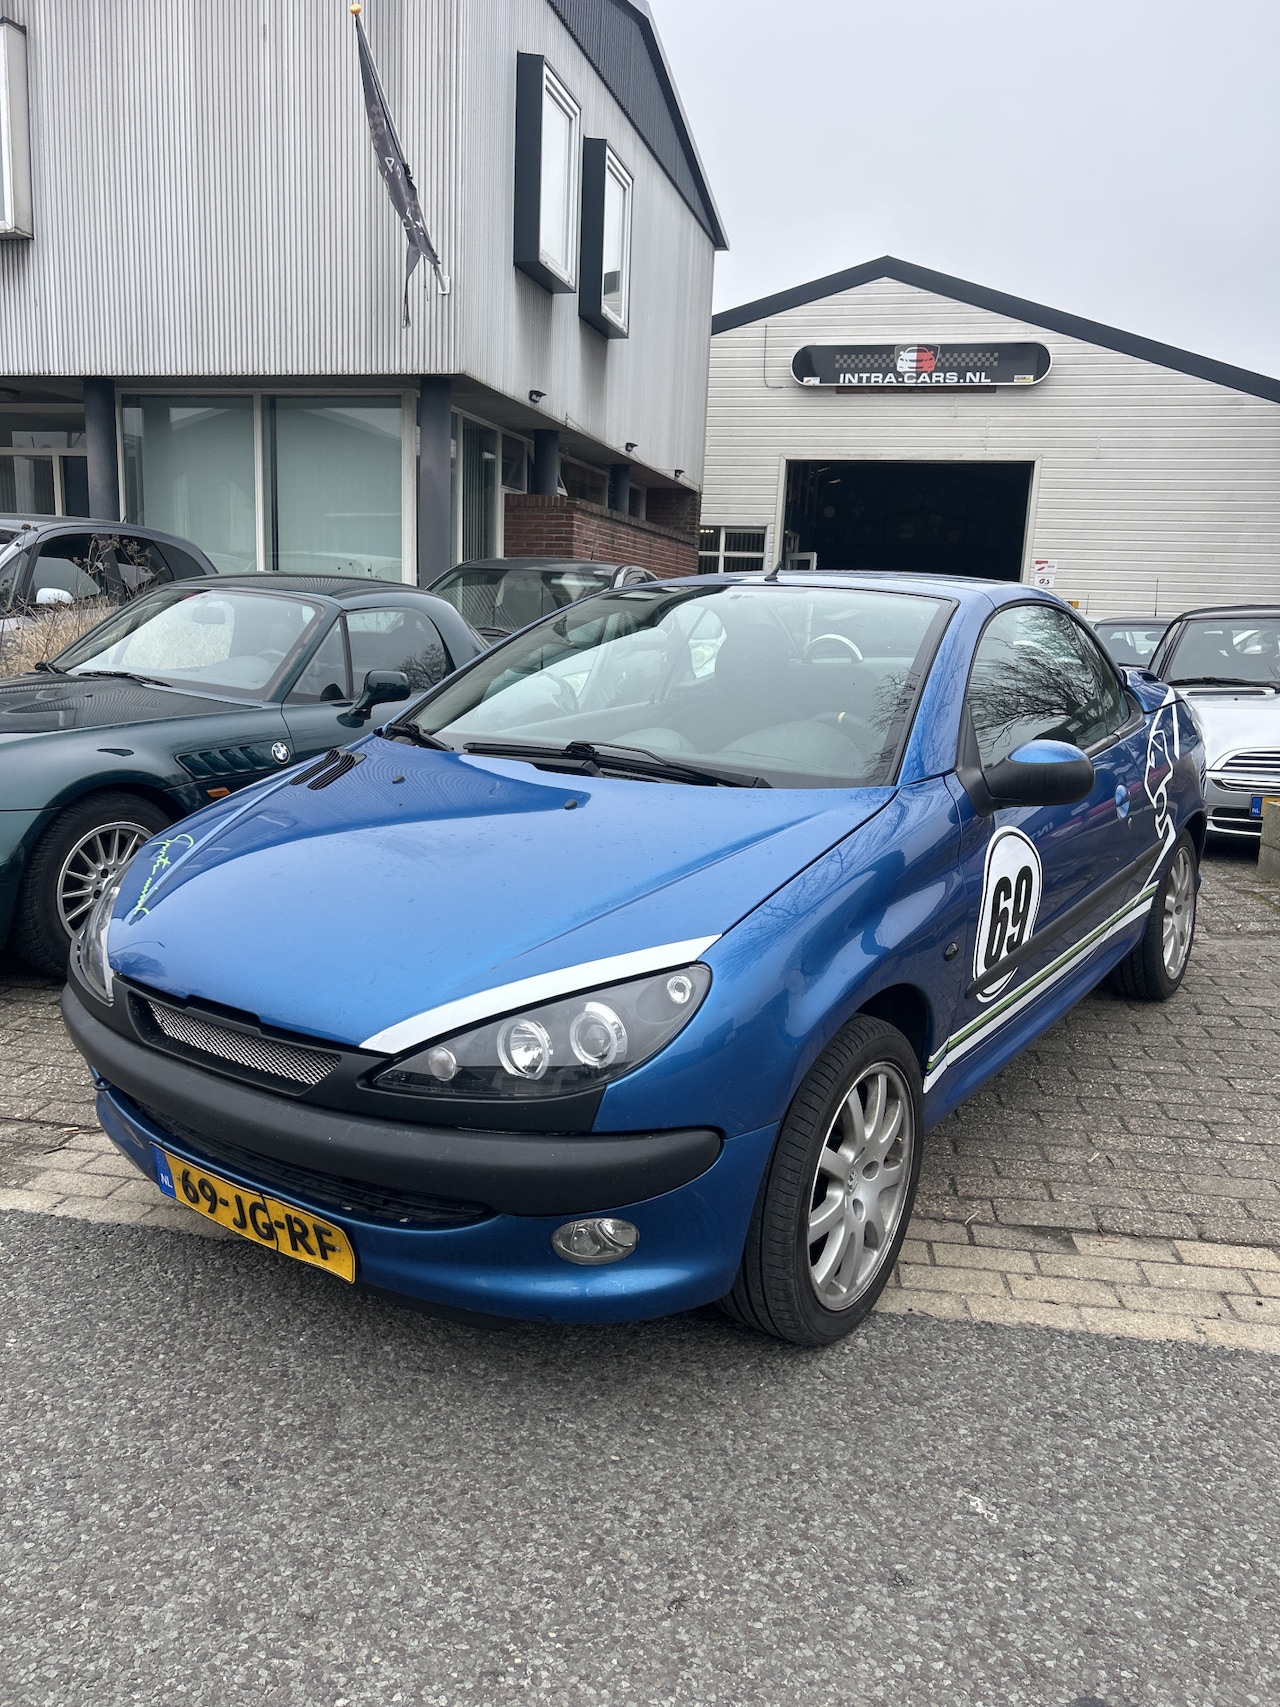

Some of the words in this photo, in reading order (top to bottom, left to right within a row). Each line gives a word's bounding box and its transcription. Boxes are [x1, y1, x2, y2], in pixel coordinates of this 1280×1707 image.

[839, 371, 991, 384] INTRA-CARS.NL
[983, 865, 1033, 970] 69
[161, 1173, 173, 1188] NL
[181, 1169, 336, 1260] 69-JG-RF
